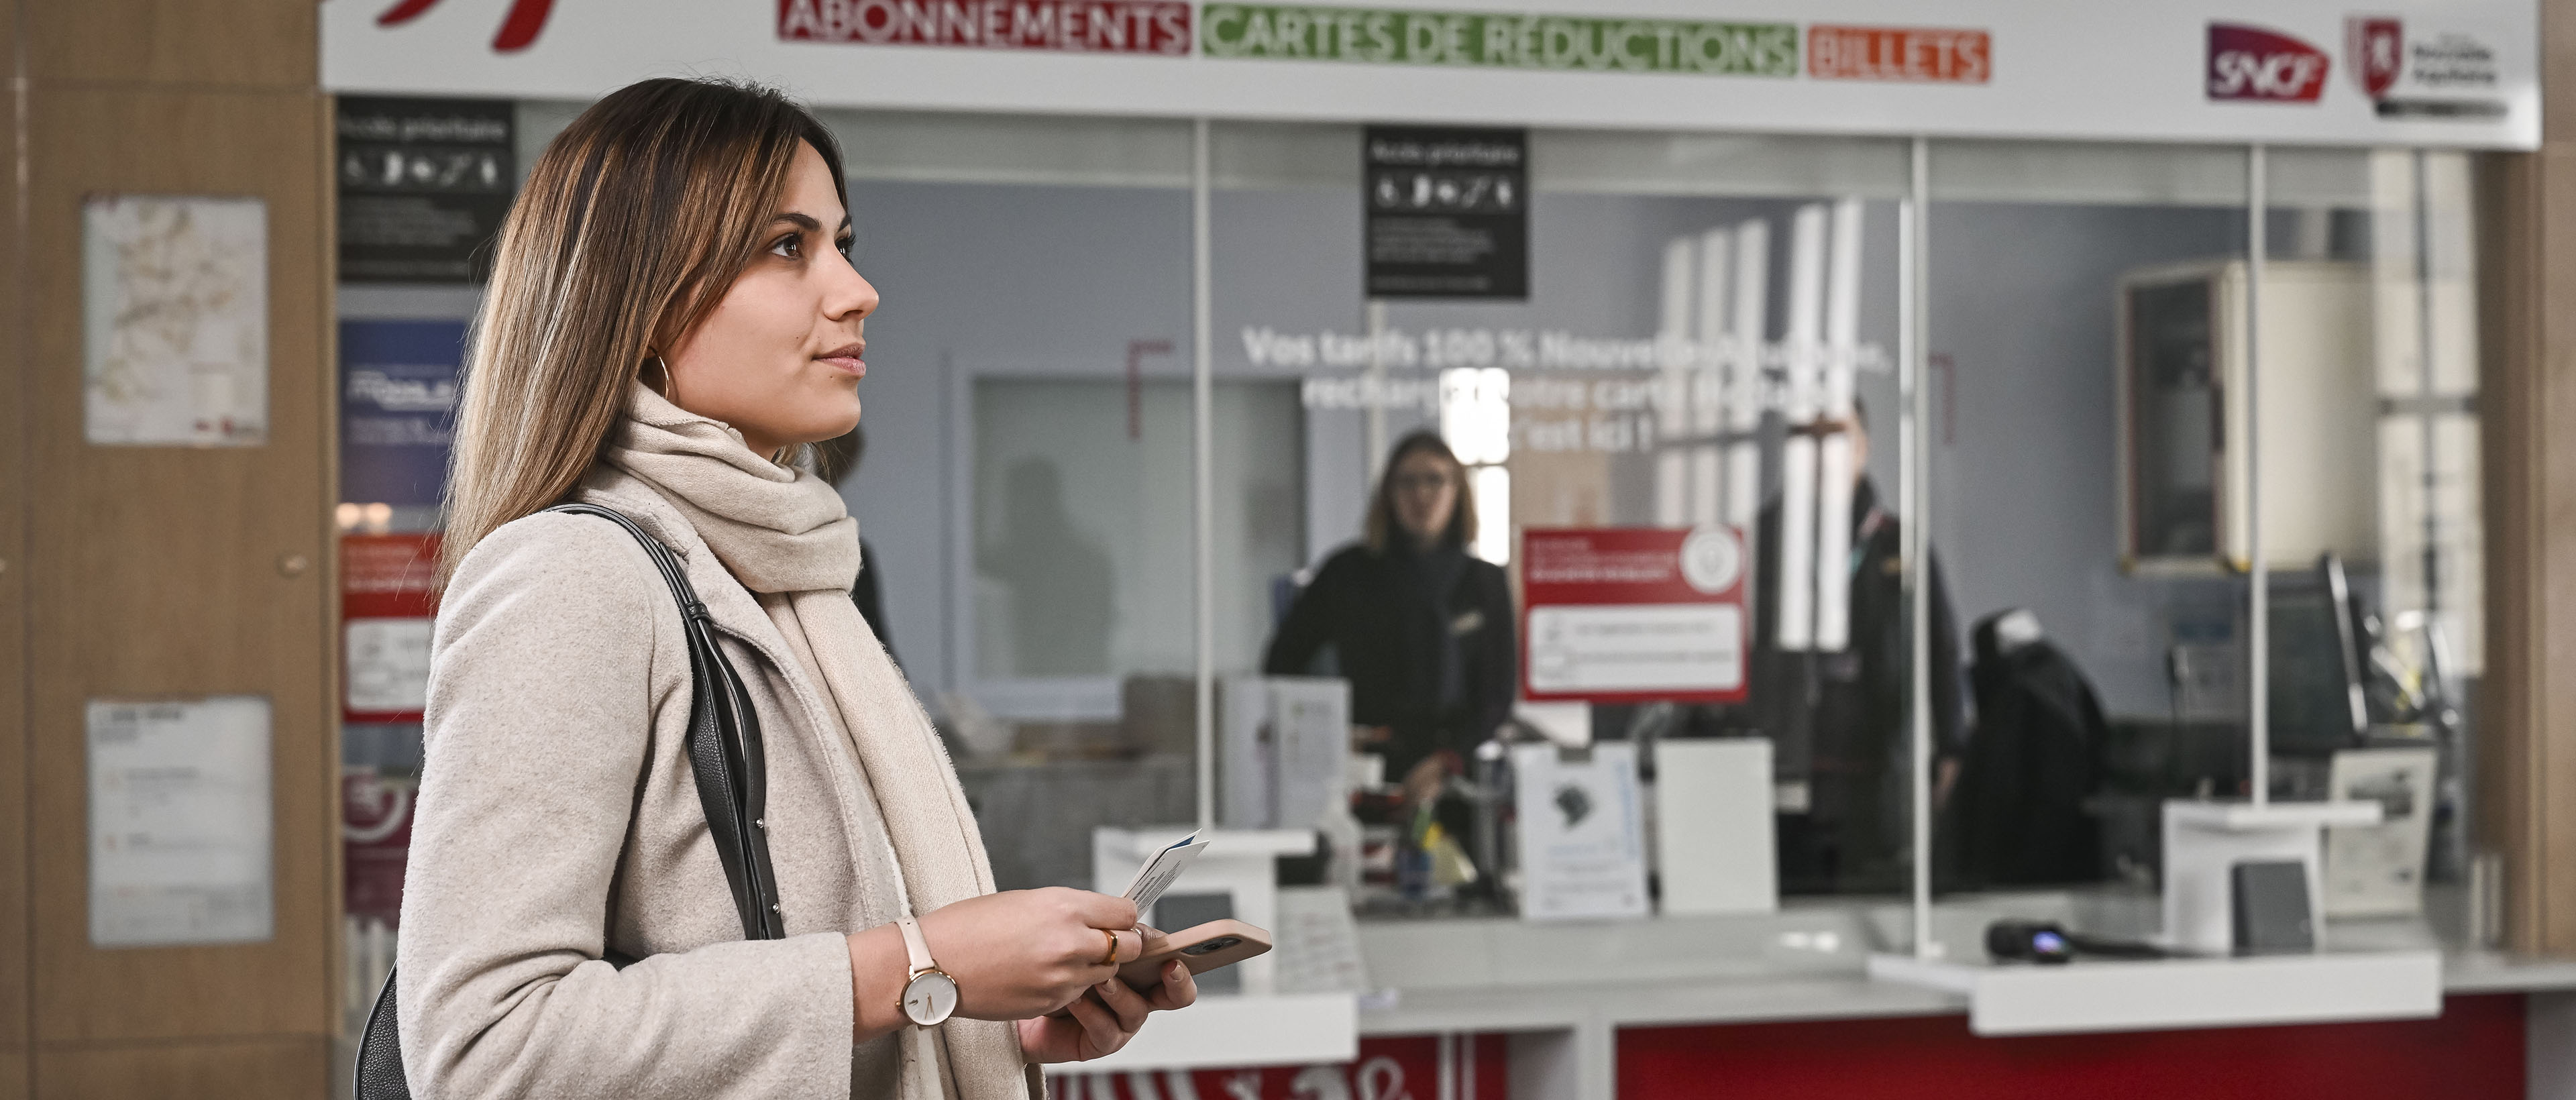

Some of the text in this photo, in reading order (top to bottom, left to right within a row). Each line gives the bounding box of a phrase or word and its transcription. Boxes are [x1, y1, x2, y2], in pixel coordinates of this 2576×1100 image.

[785, 0, 1185, 54] ABONNEMENTS
[1207, 7, 1796, 76] CARTES DE RÉDUCTIONS
[1813, 30, 1984, 81] BILLETS
[2214, 50, 2320, 97] SNCF
[1241, 327, 1314, 366] Vos
[1422, 327, 1496, 368] 100
[1498, 328, 1535, 368] %
